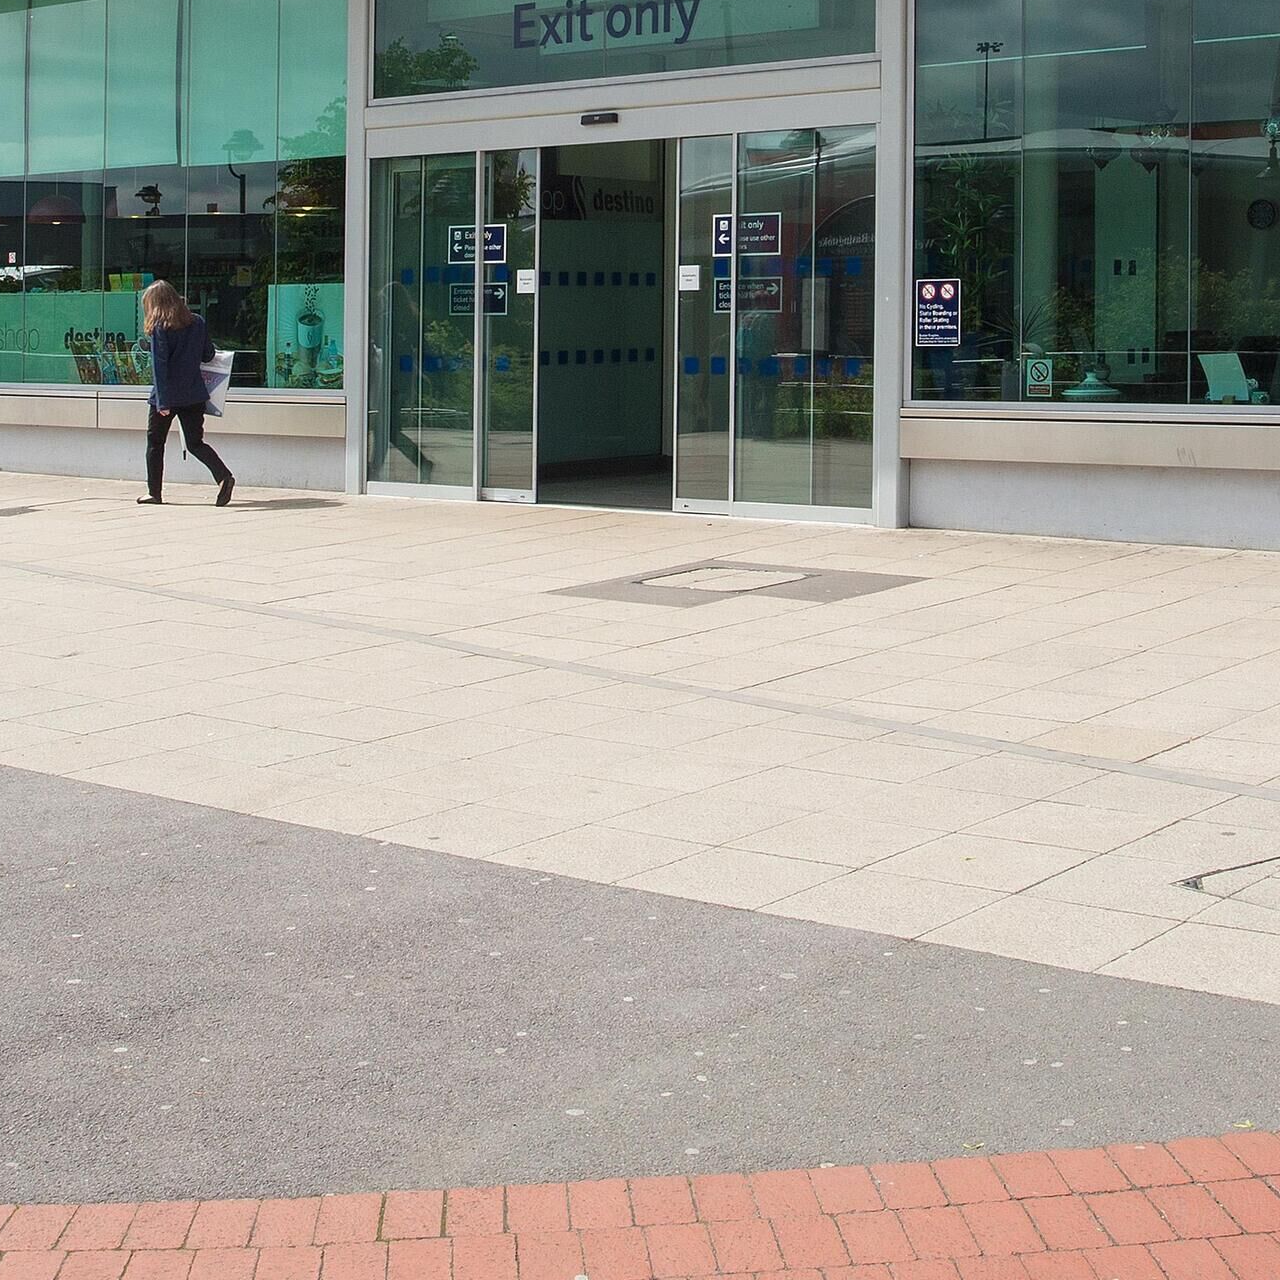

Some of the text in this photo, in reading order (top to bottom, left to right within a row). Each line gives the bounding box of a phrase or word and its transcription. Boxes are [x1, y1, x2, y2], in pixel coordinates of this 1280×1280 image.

[513, 0, 594, 49] Exit
[542, 187, 655, 217] op destino
[747, 219, 764, 230] only
[453, 287, 476, 295] Entranc
